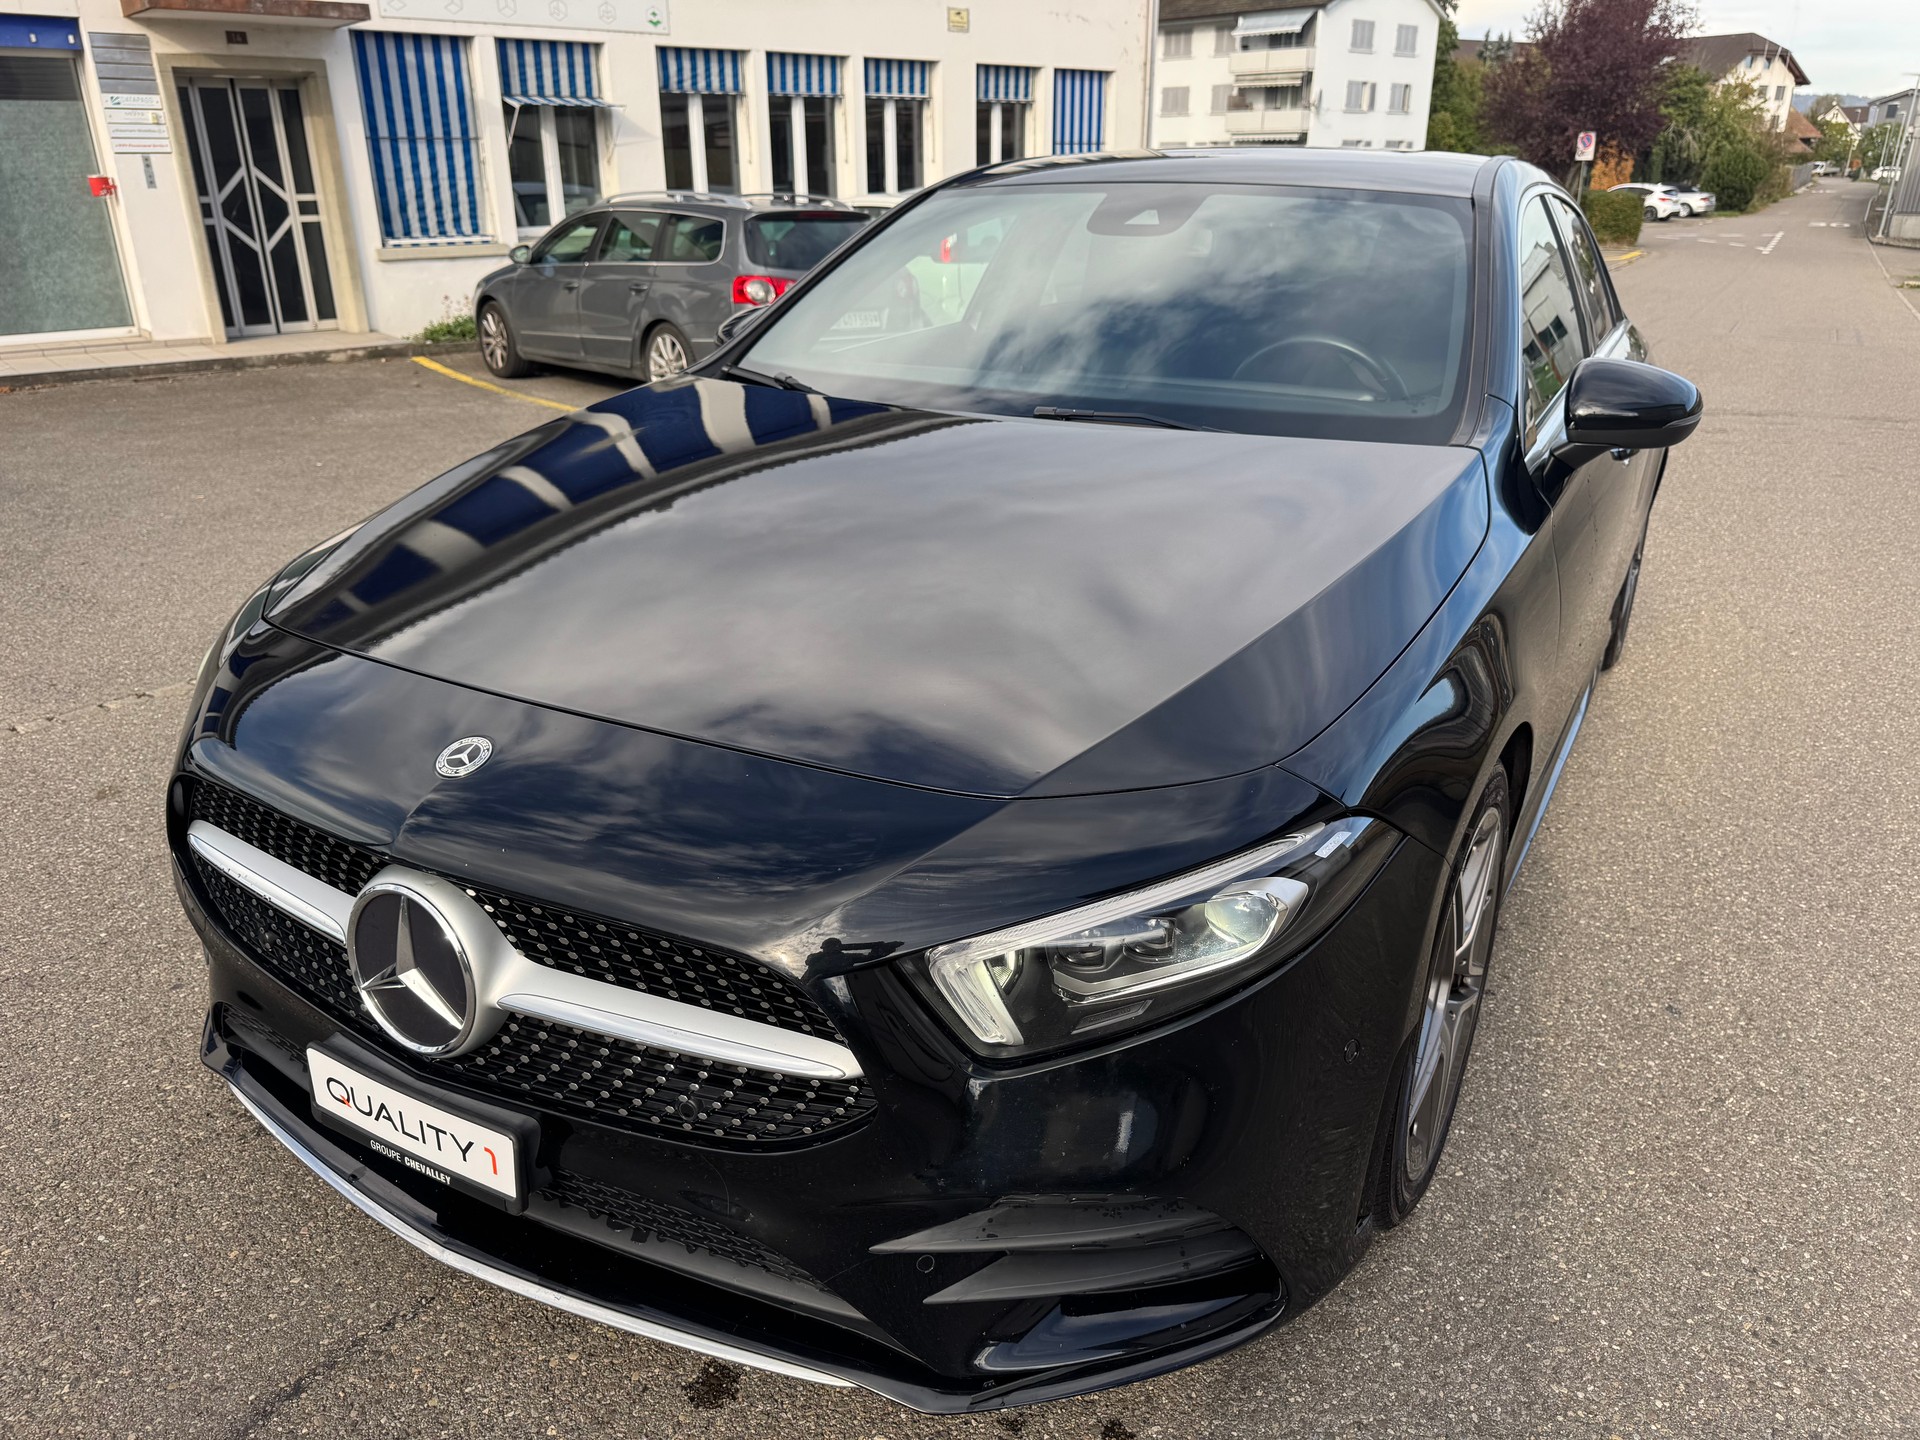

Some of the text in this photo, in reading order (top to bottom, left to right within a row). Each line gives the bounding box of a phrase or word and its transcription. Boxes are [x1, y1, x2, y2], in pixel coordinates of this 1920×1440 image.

[326, 1077, 498, 1175] QUALITY 1
[370, 1139, 451, 1186] GROUPE CHEVALLEY
